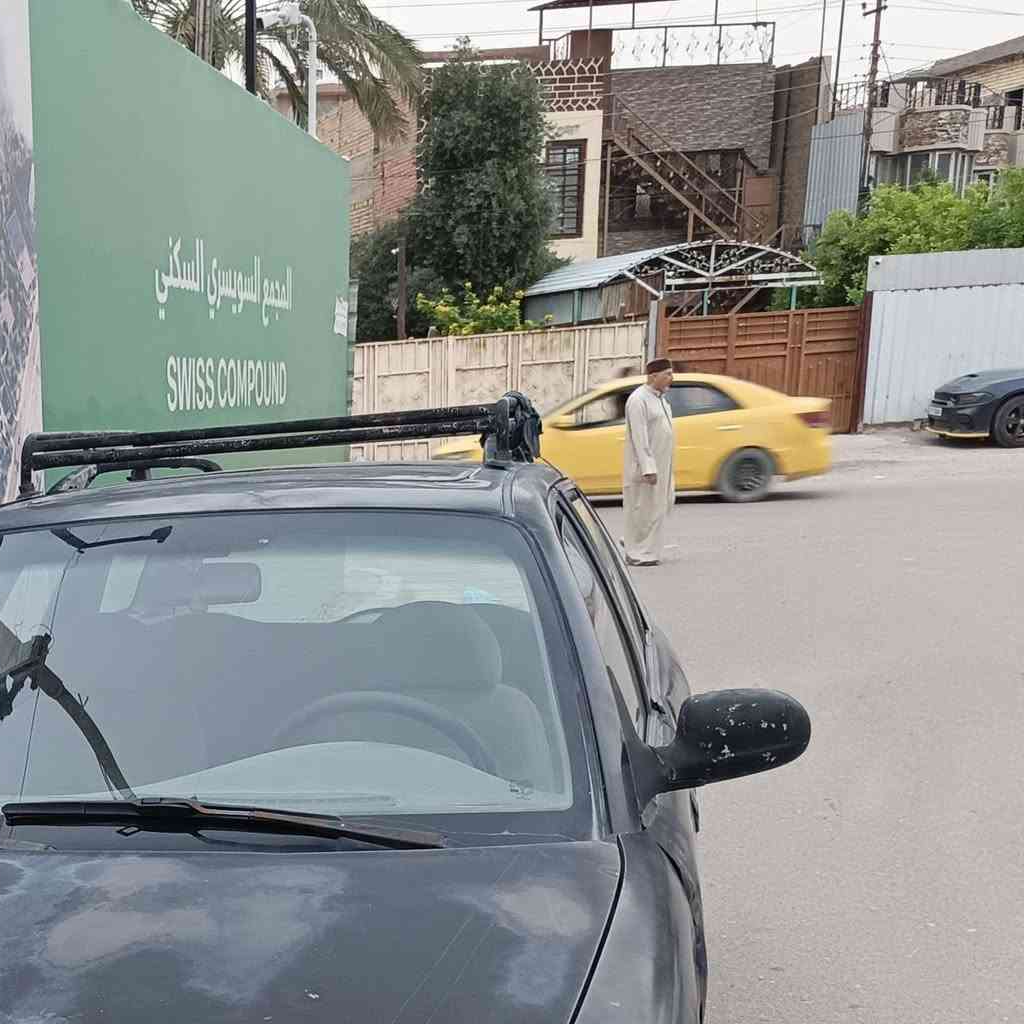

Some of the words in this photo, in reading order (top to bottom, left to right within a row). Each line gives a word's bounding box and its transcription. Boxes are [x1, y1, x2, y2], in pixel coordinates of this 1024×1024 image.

[155, 237, 204, 320] السكني
[207, 256, 261, 320] السويسري
[262, 266, 293, 327] المجمع
[167, 355, 215, 412] SWISS
[217, 357, 287, 408] COMPOUND
